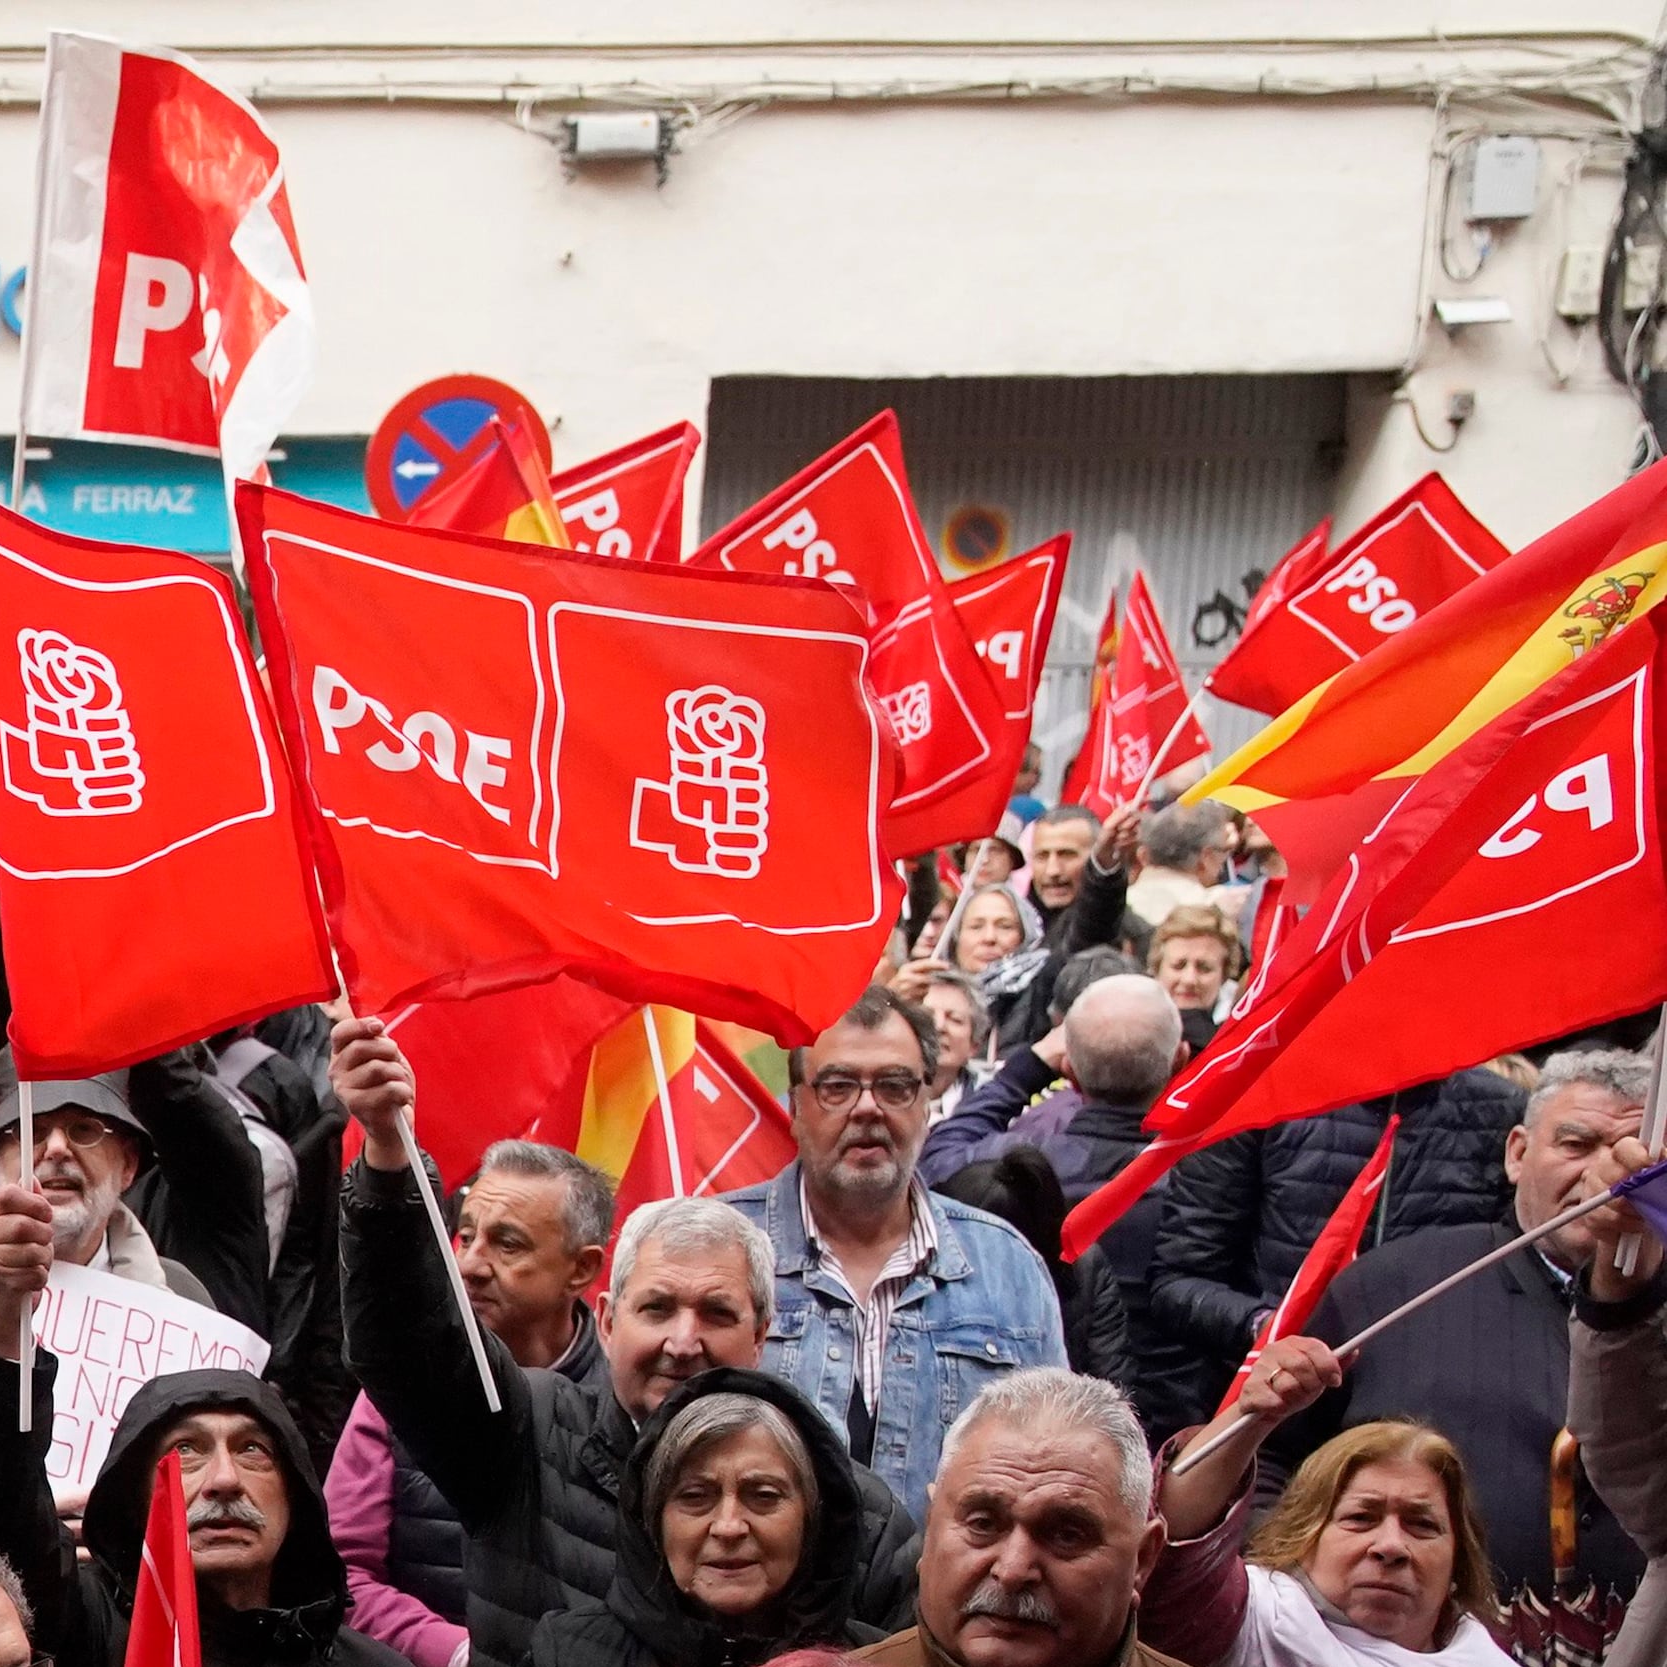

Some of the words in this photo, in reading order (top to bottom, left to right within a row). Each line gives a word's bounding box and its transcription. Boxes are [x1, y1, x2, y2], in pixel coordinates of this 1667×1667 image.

[72, 485, 196, 514] FERRAZ
[1325, 556, 1417, 633] PSO
[312, 664, 512, 827] PSOE
